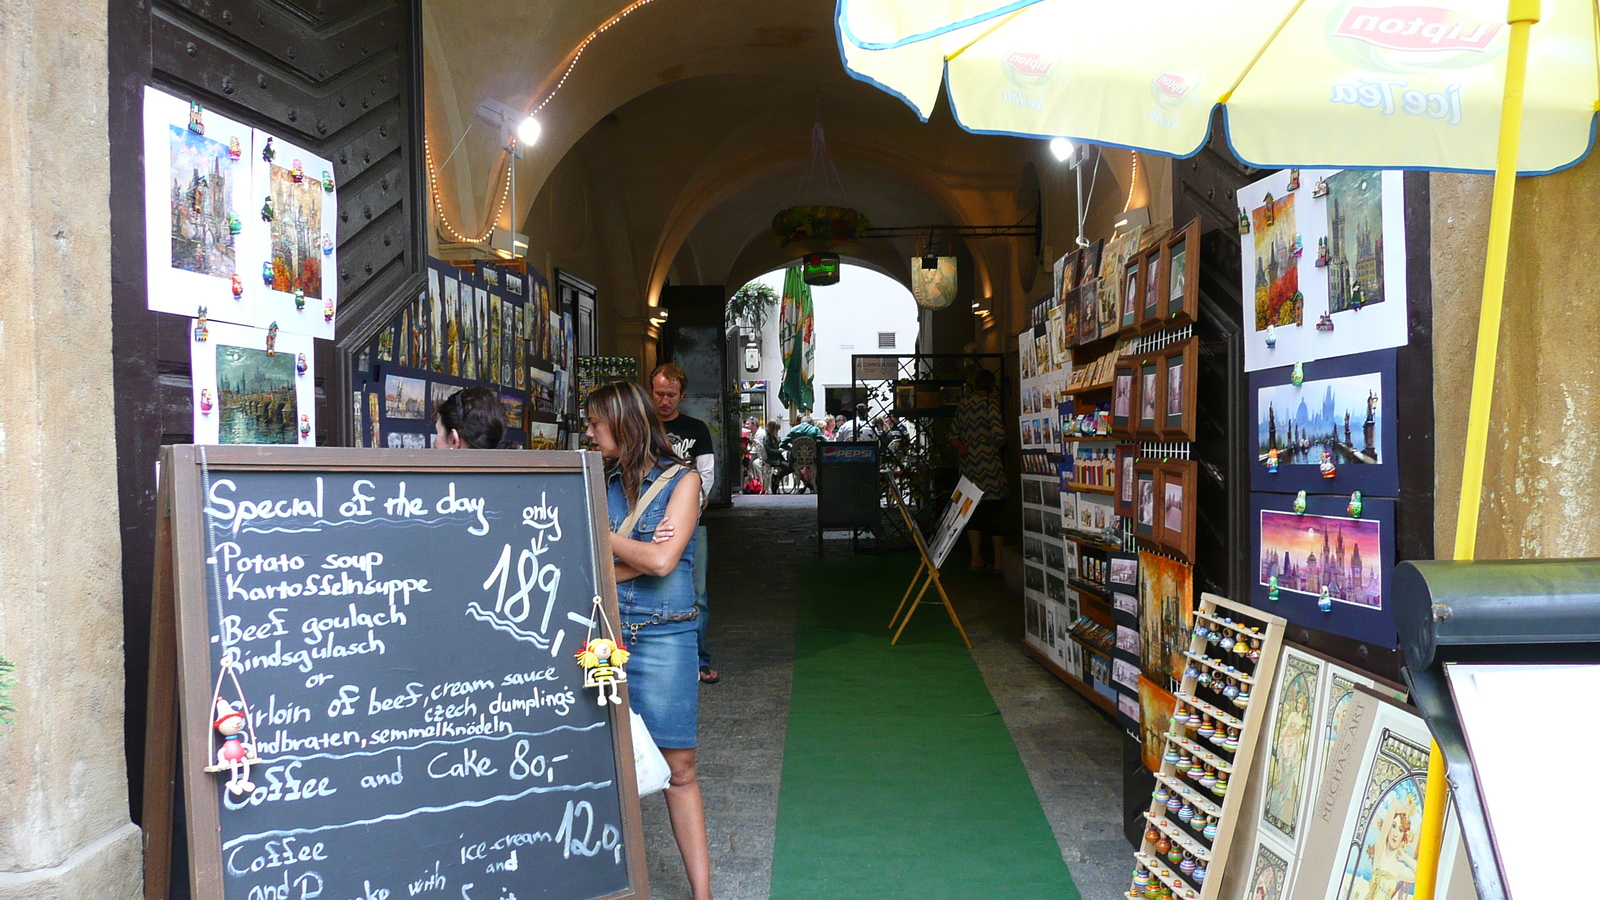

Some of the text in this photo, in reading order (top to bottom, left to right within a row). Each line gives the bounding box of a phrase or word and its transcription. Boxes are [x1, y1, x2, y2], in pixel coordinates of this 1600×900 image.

[836, 449, 873, 458] PEPSI
[203, 476, 490, 541] Special of the day
[522, 491, 562, 542] only
[321, 552, 383, 581] soup
[225, 571, 432, 606] Kartoffelnsuppe
[301, 603, 407, 644] goulach
[305, 673, 334, 688] or
[328, 685, 360, 717] of
[431, 679, 495, 701] cream
[501, 667, 559, 686] sauce
[424, 697, 477, 723] czech
[1348, 704, 1364, 737] ART
[223, 760, 337, 811] Coffee
[360, 755, 404, 788] and
[227, 836, 328, 878] Coffee
[486, 850, 519, 873] and
[408, 860, 447, 896] with
